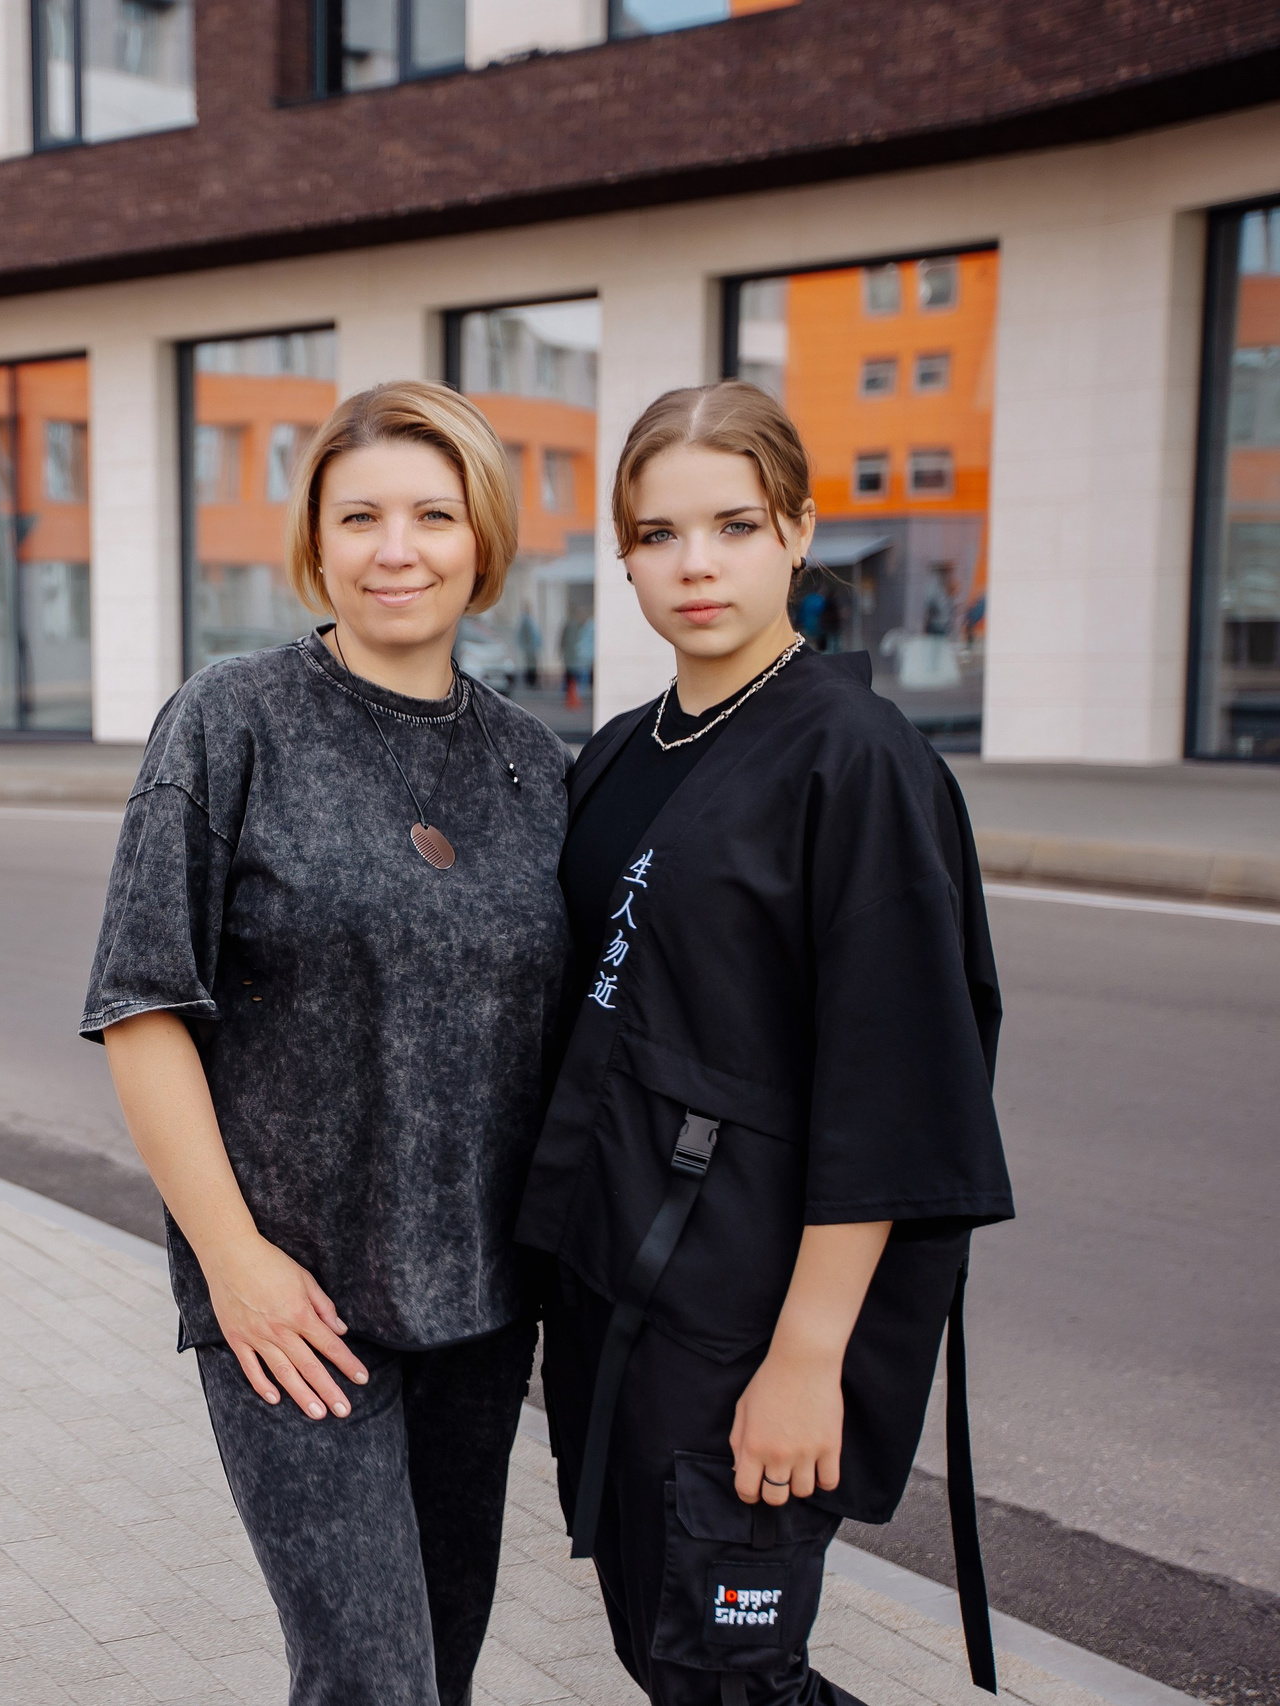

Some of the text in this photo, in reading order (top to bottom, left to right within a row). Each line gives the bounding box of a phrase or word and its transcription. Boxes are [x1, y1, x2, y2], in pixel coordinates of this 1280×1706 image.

[588, 849, 654, 1009] 生人勿近
[714, 1584, 782, 1610] Jogger
[715, 1607, 778, 1625] Street
